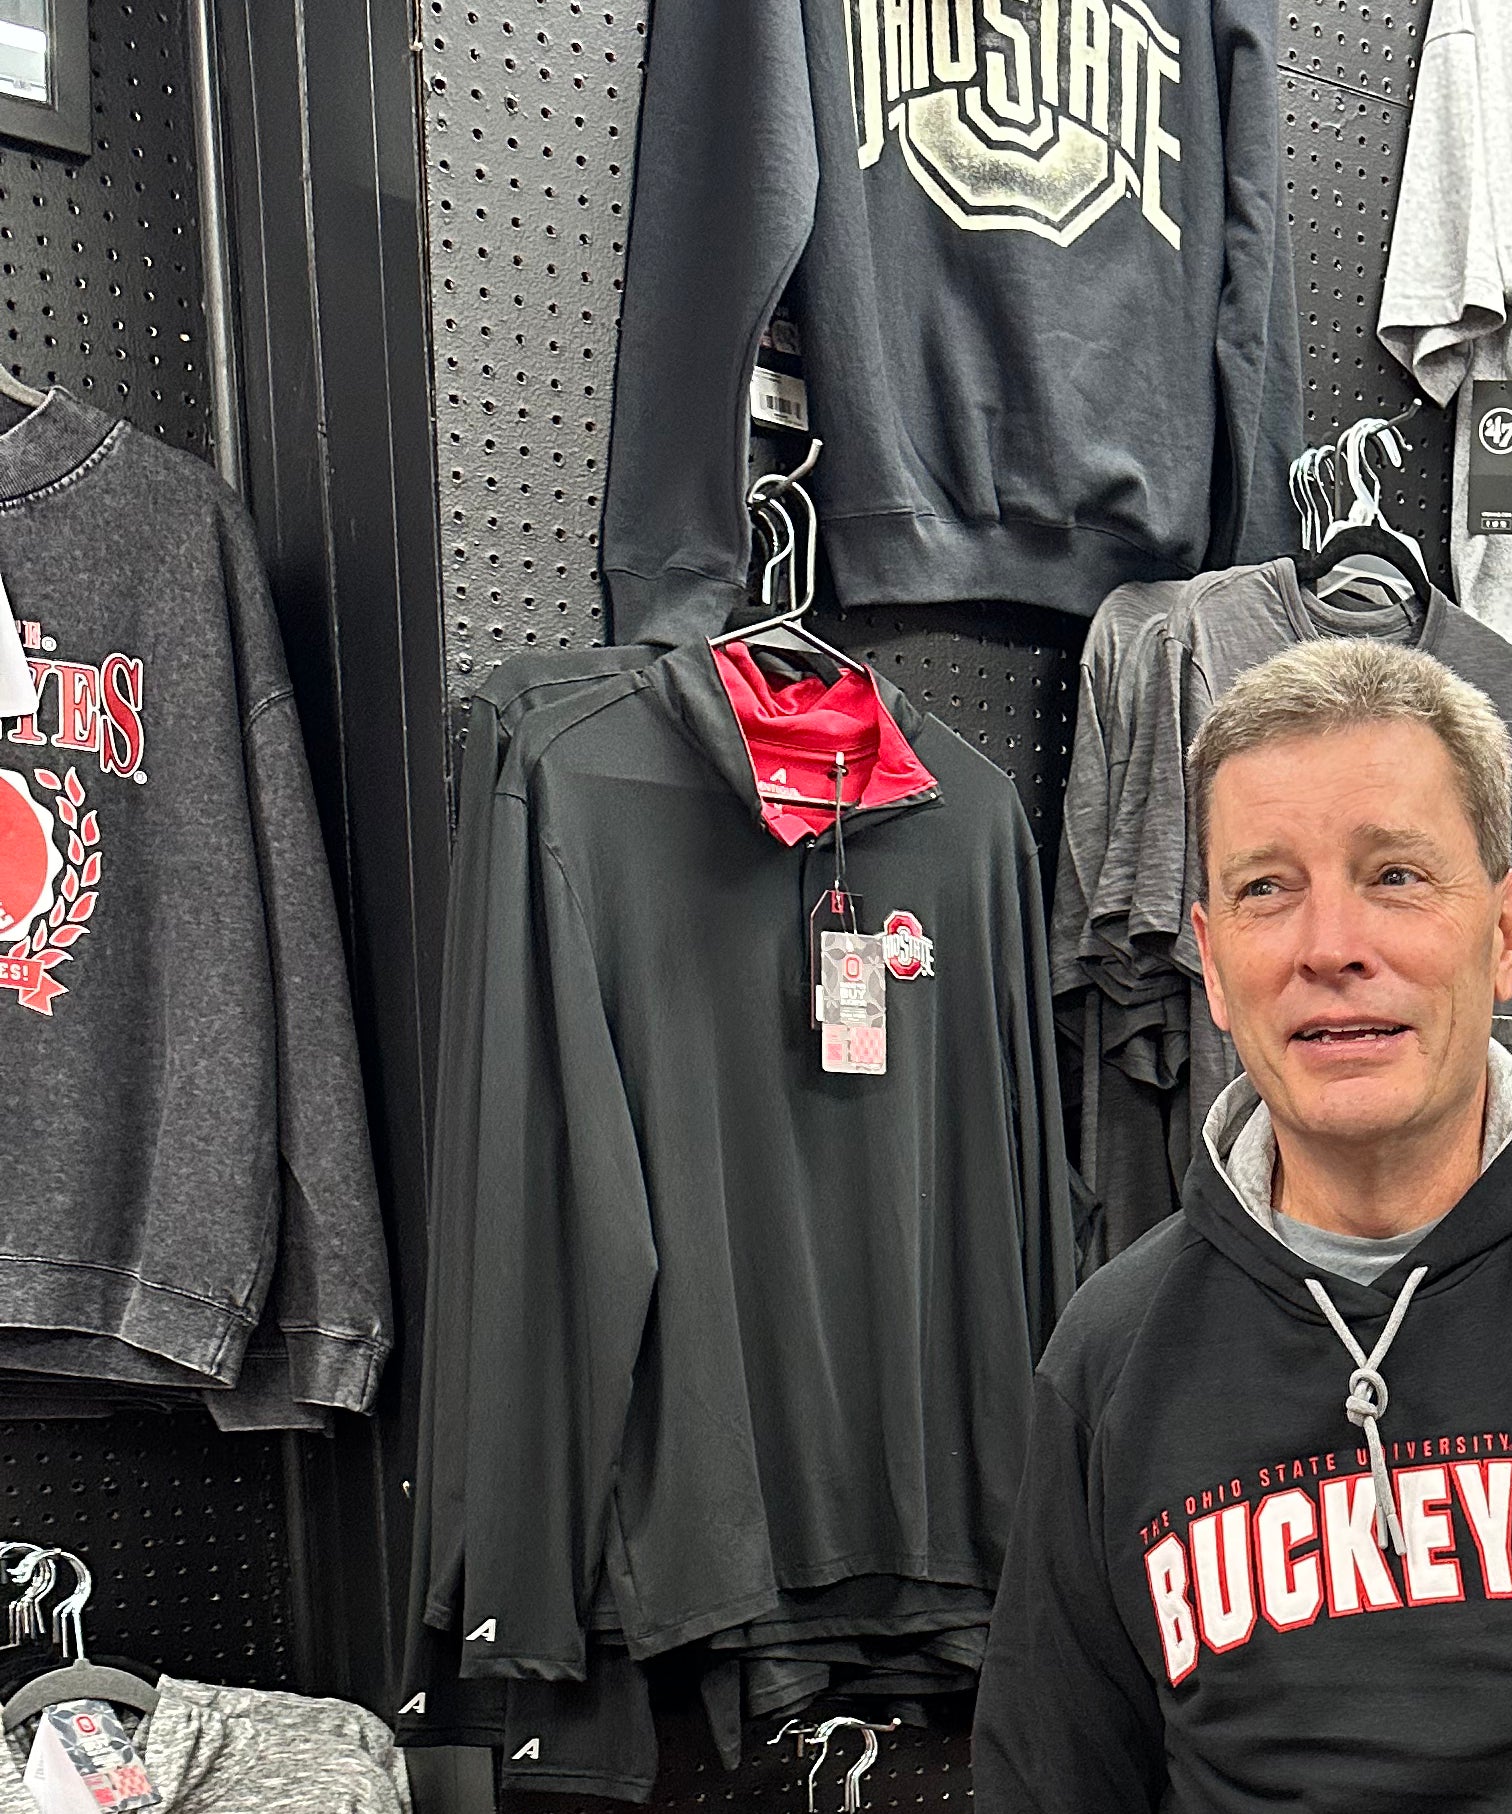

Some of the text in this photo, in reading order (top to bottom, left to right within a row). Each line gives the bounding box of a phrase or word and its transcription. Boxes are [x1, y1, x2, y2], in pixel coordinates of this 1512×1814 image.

[1140, 1432, 1512, 1545] THE OHIO STATE UIVERSITY
